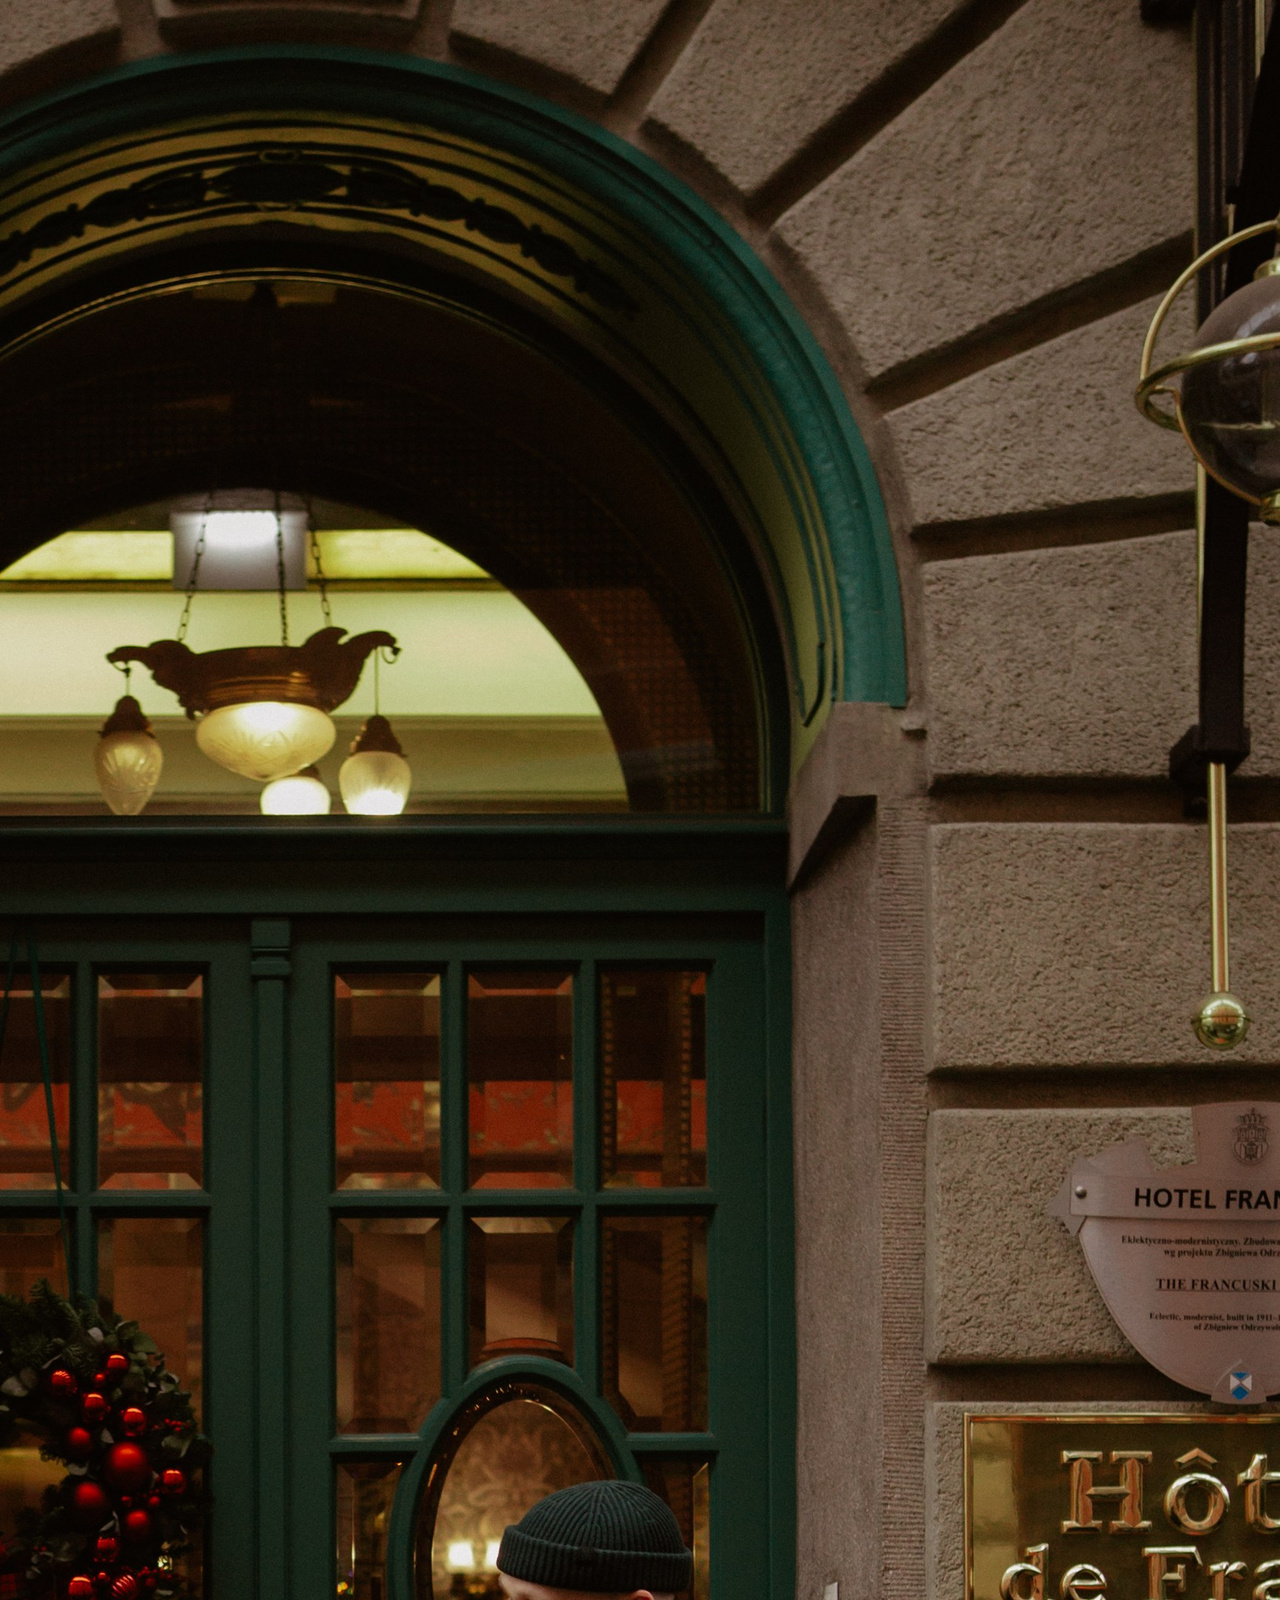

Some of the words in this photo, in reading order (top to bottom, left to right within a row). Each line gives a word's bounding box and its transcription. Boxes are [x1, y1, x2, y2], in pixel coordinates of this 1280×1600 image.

[1134, 1187, 1217, 1209] HOTEL
[1163, 1249, 1176, 1258] wg
[1177, 1248, 1213, 1259] projektu
[1215, 1248, 1258, 1259] Zbigniewa
[1156, 1278, 1186, 1290] THE
[1191, 1279, 1277, 1291] FRANCUSKI
[1149, 1312, 1182, 1322] Eclectic,
[1183, 1313, 1225, 1322] modernist,
[1226, 1313, 1245, 1321] built
[1193, 1323, 1202, 1331] of
[1203, 1323, 1239, 1333] Zbigniew
[1060, 1447, 1280, 1536] Hôt
